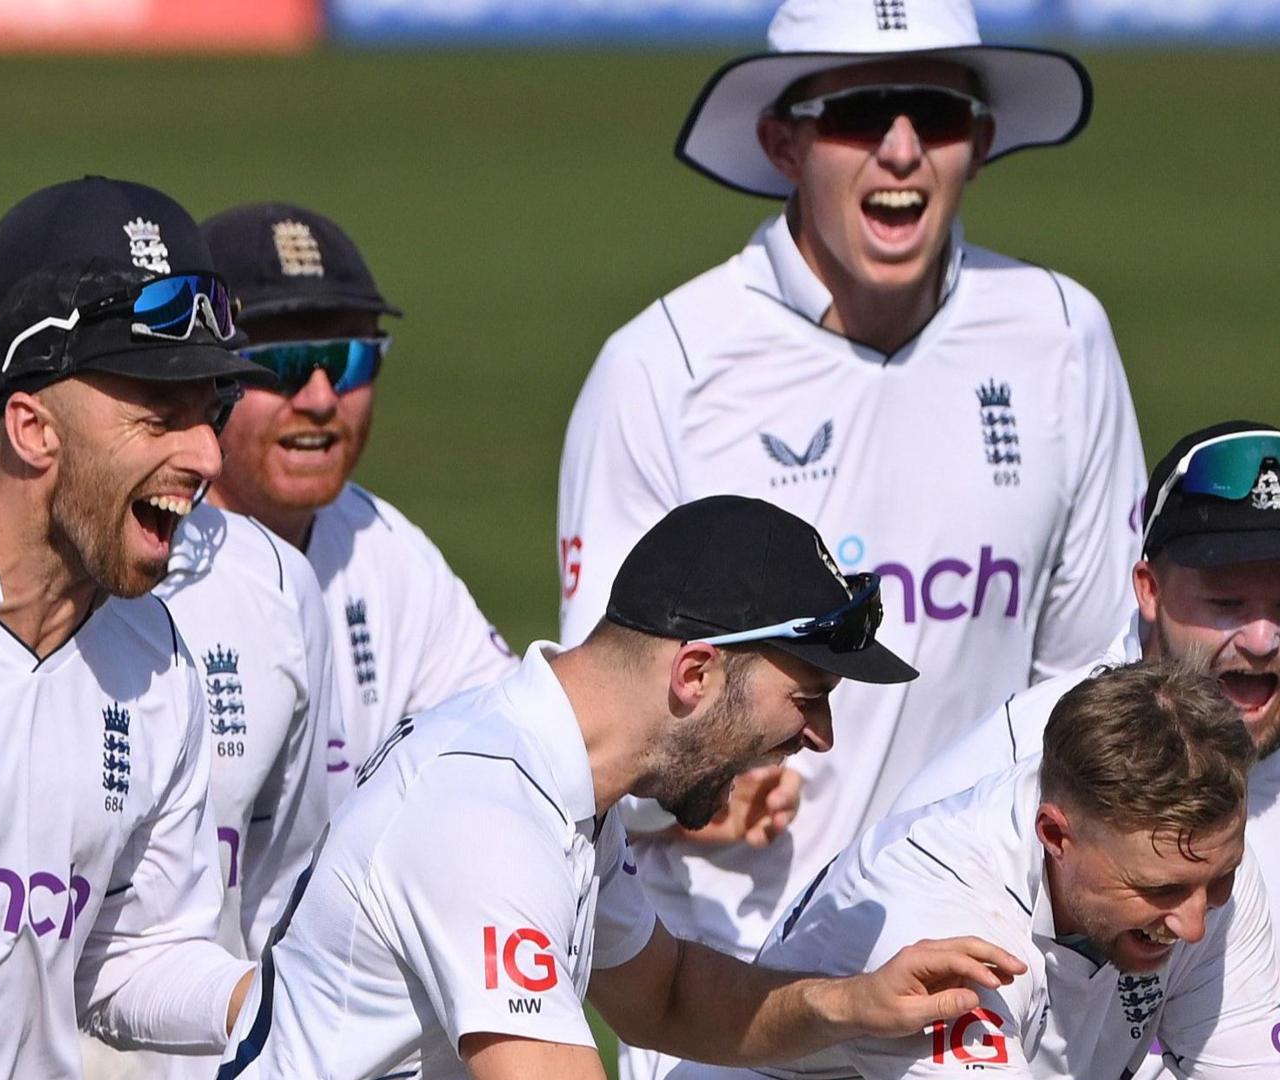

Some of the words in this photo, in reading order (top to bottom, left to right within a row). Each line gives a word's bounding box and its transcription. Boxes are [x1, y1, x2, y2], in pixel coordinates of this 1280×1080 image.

[837, 535, 1019, 623] nch
[217, 741, 245, 757] 689
[104, 796, 125, 814] 684
[483, 926, 559, 992] IG
[508, 998, 542, 1014] MW
[933, 1007, 1009, 1065] IG
